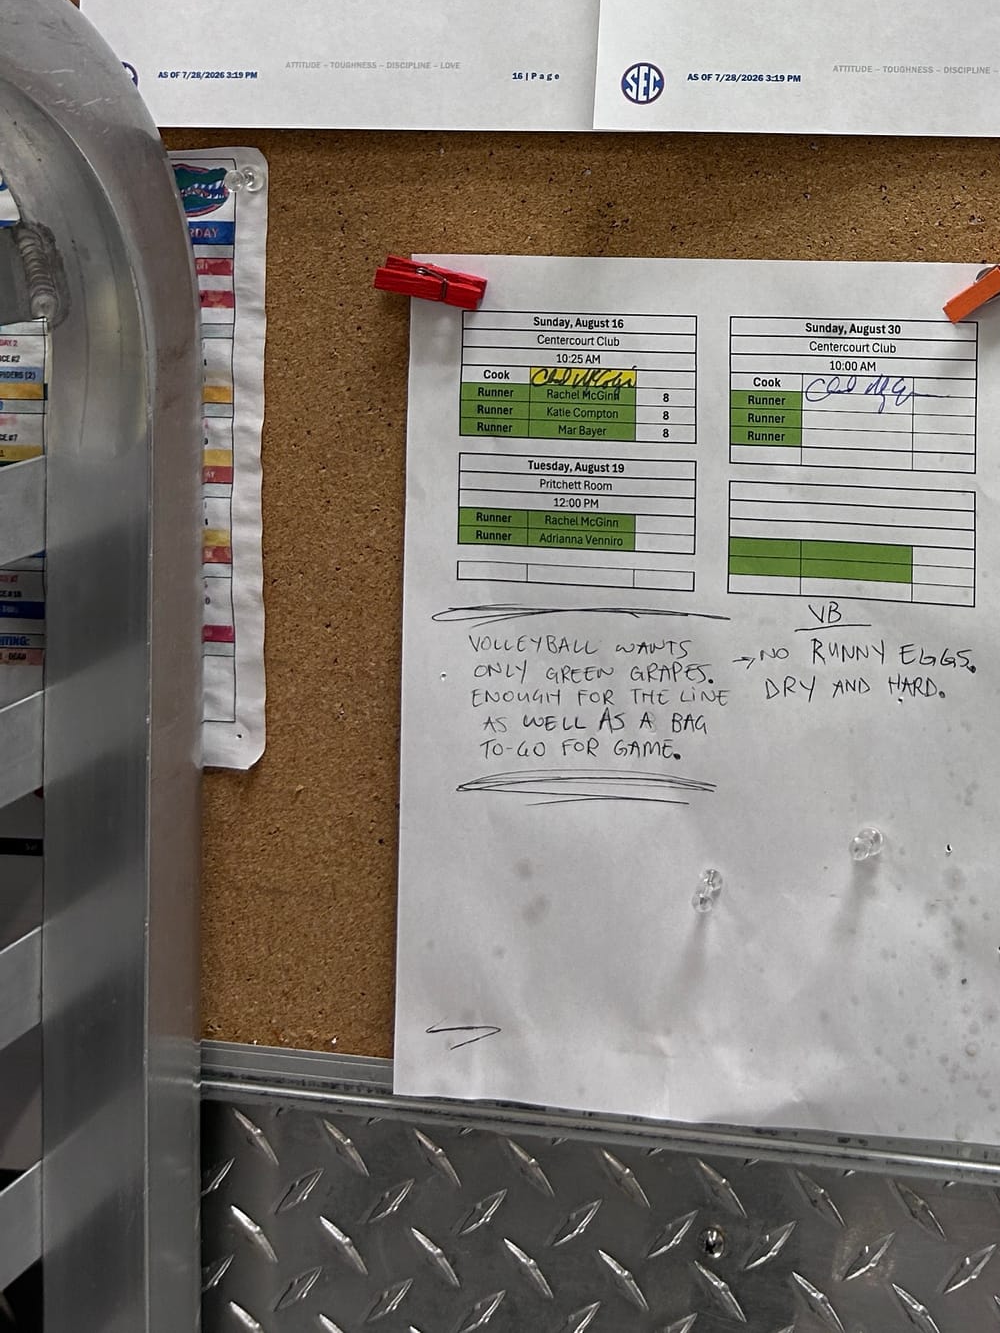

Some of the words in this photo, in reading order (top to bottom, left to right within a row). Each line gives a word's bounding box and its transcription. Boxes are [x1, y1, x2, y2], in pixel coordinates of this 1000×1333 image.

[157, 71, 169, 79] AS
[169, 71, 181, 79] OF
[181, 71, 226, 80] 7/28/2026
[226, 71, 244, 79] 3:19
[244, 71, 258, 79] PM
[625, 65, 661, 101] SEC
[533, 316, 573, 328] Sunday,
[575, 318, 610, 330] August
[612, 319, 624, 328] 16
[805, 323, 847, 335] Sunday,
[849, 323, 886, 335] August
[888, 324, 901, 334] 30
[537, 335, 595, 346] Centercourt
[596, 337, 620, 346] Club
[556, 354, 583, 364] 10:25
[585, 354, 601, 364] AM
[483, 369, 510, 380] Cook
[478, 387, 514, 397] Runner
[547, 389, 580, 400] Rachel
[547, 408, 572, 418] Katie
[573, 408, 619, 420] Compton
[558, 425, 578, 435] Mar
[579, 425, 607, 437] Bayer
[528, 460, 573, 472] Tuesday,
[575, 462, 610, 474] August
[612, 463, 624, 473] 19
[540, 479, 582, 490] Pritchett
[584, 480, 612, 491] Room
[539, 533, 583, 544] Adrianna
[585, 535, 623, 546] Venniro
[807, 602, 844, 624] VB
[467, 633, 598, 656] VOLLEYBALL
[614, 639, 692, 658] WANTS
[759, 647, 790, 662] NO
[810, 637, 886, 668] RUNNY
[472, 660, 530, 684] ONLY
[545, 665, 616, 684] GREEN
[764, 675, 817, 702] DRY
[831, 678, 872, 696] AND
[577, 687, 616, 707] FOR
[632, 689, 671, 707] THE
[482, 714, 508, 734] AS
[522, 712, 588, 732] WELL
[597, 706, 627, 732] AS
[638, 710, 655, 731] A
[670, 711, 709, 734] BAG
[561, 736, 600, 759] FOR
